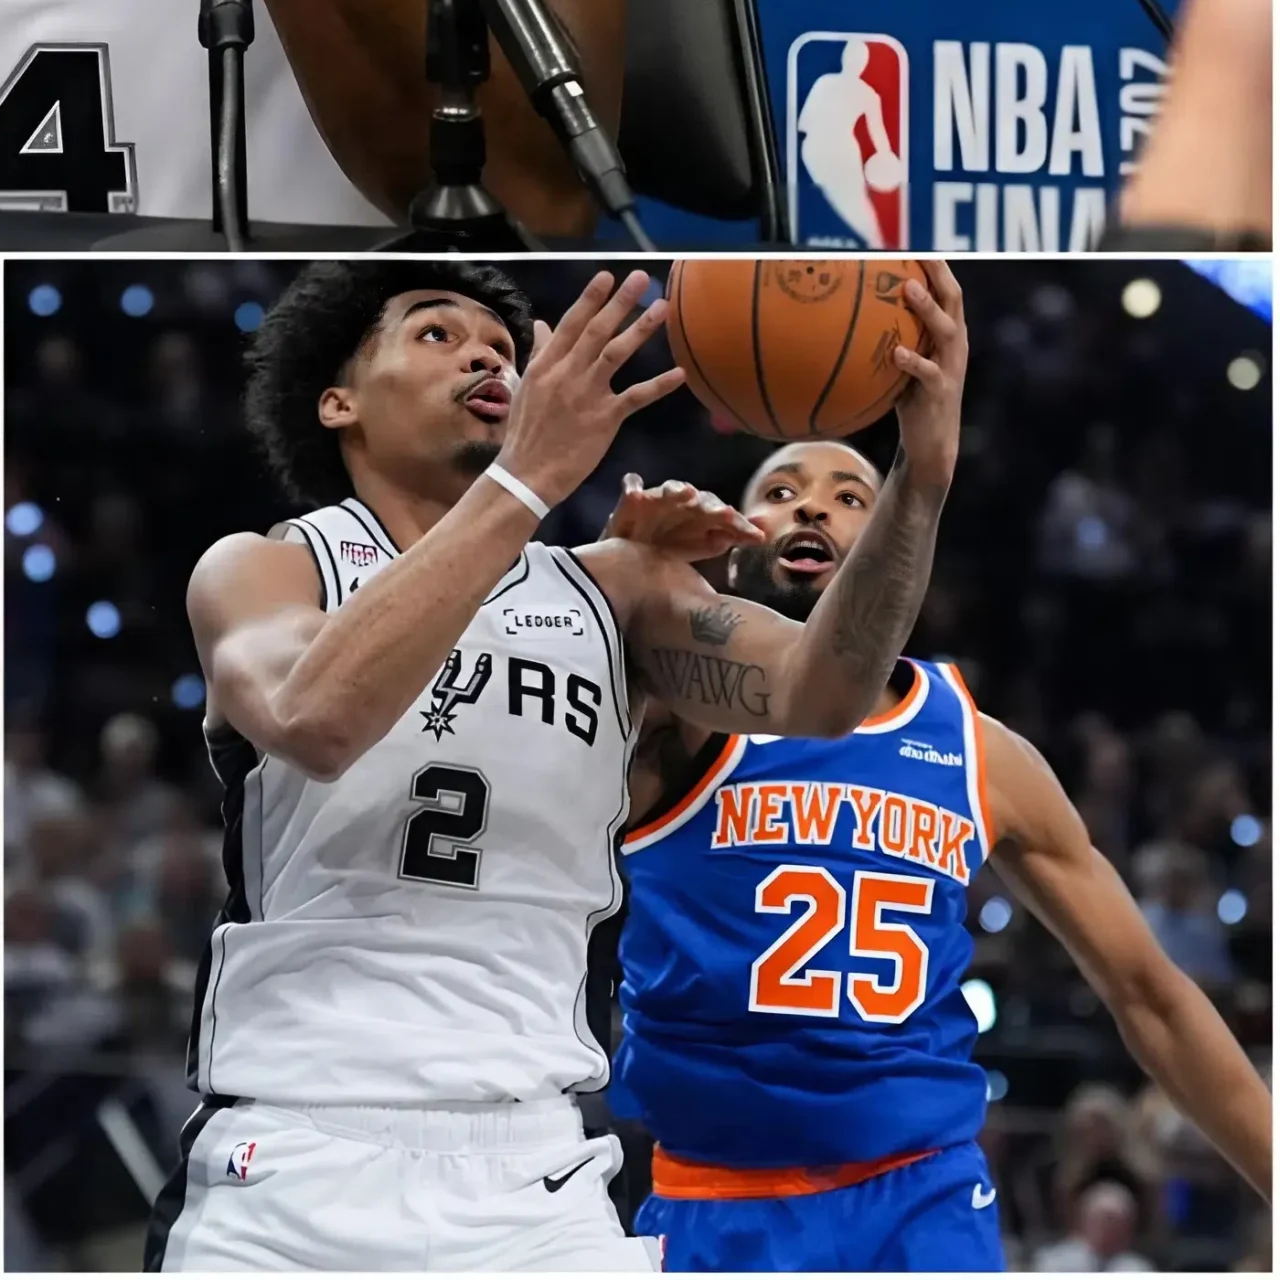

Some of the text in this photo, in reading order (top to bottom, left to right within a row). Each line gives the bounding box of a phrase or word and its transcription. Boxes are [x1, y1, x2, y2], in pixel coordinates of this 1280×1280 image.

[933, 39, 1105, 177] NBA
[397, 761, 492, 891] 2
[710, 781, 975, 886] NEW YORK
[748, 864, 935, 1024] 25
